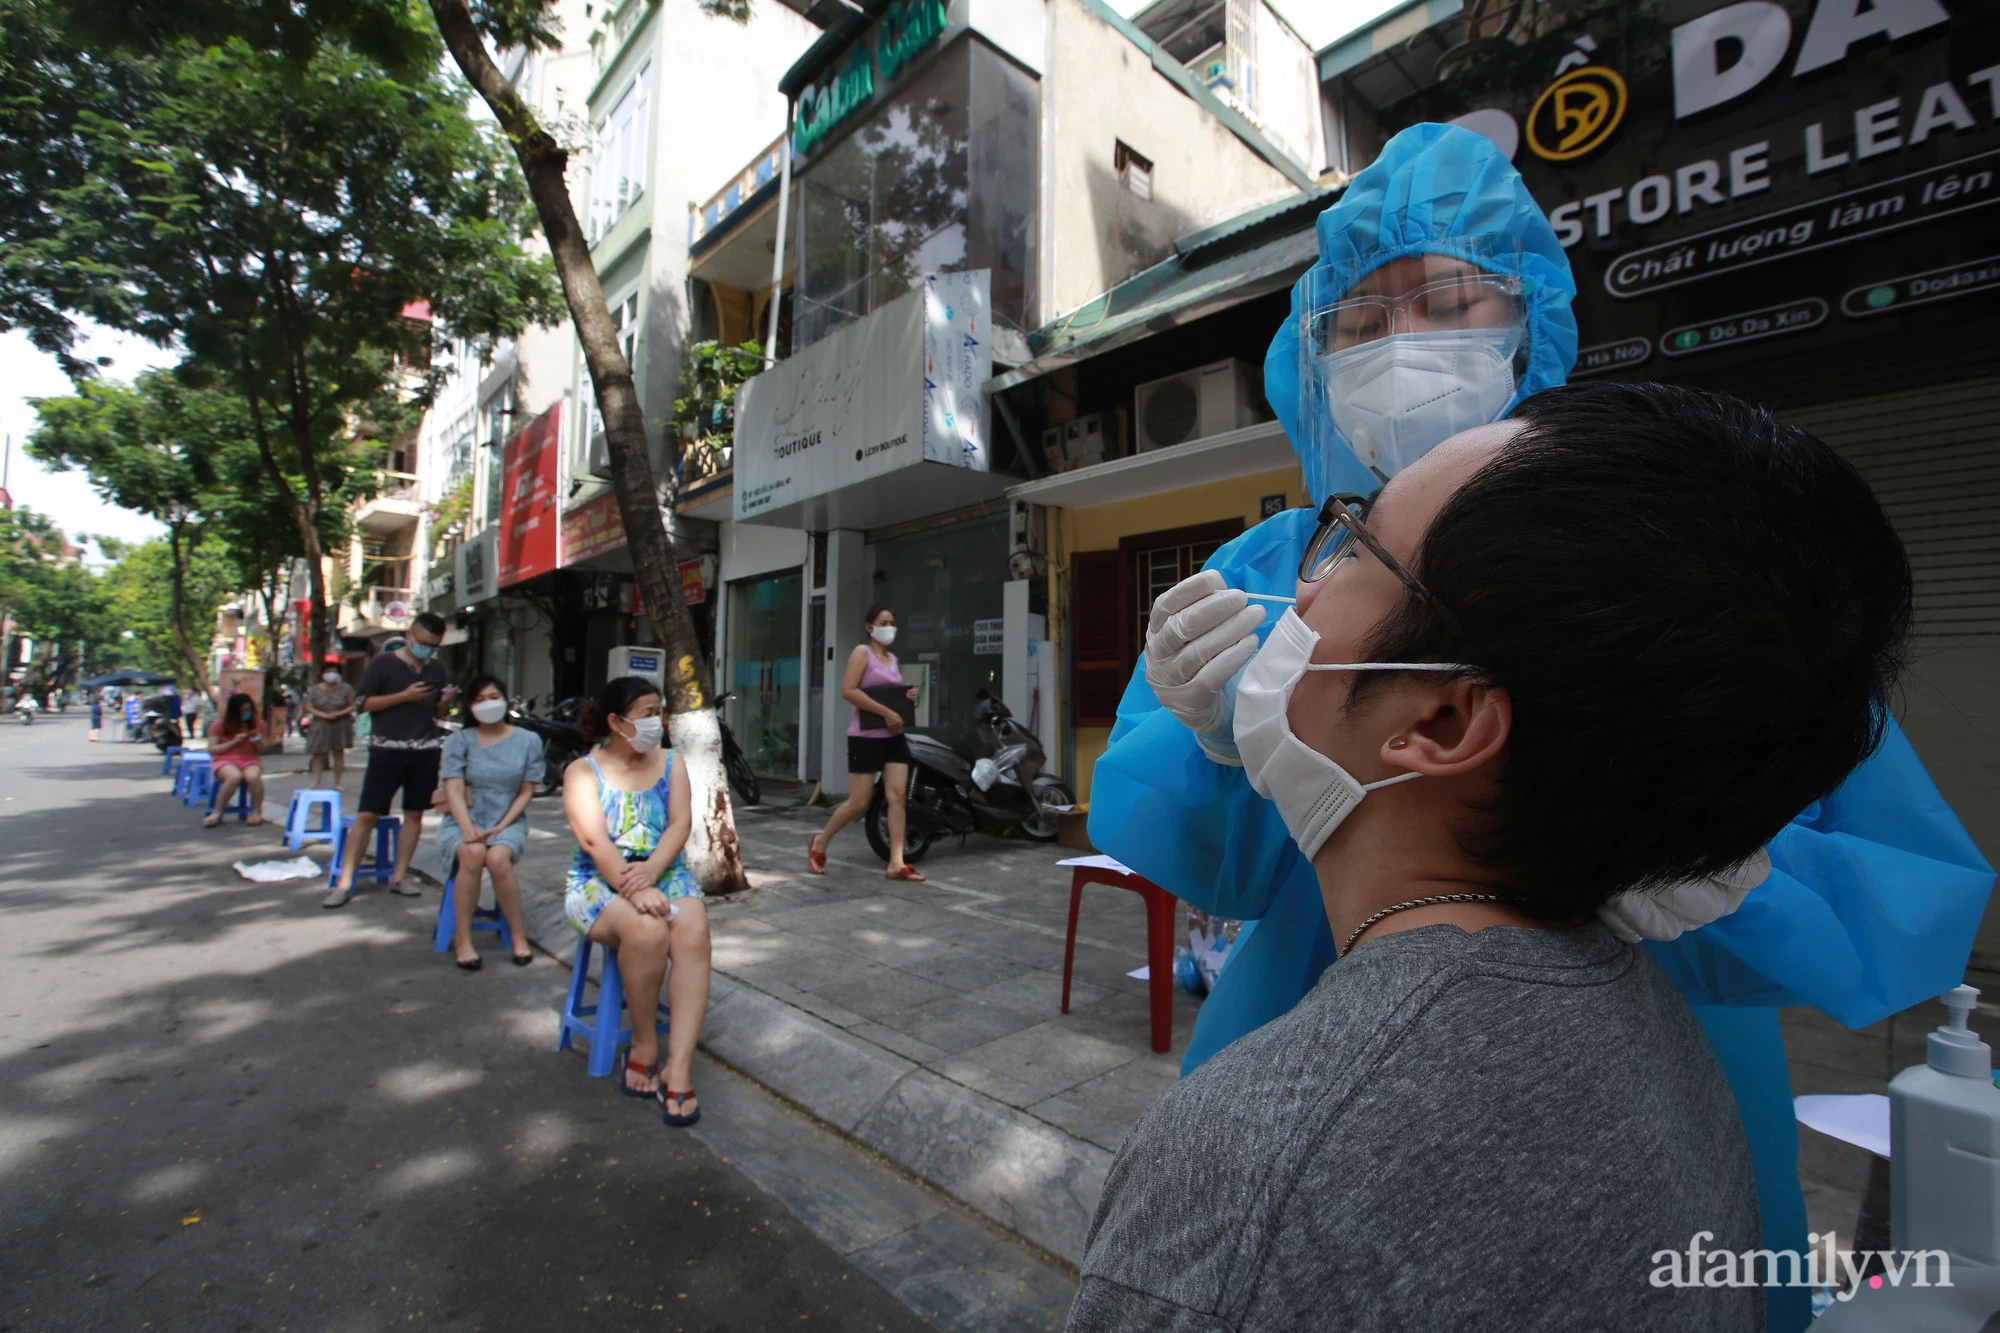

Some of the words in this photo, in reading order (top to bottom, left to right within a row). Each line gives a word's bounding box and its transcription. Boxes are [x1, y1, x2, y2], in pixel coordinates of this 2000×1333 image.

[1671, 0, 1952, 121] DA
[1550, 141, 1771, 249] STORE
[1616, 246, 1697, 286] Chất
[1705, 219, 1816, 263] lượng
[1828, 194, 1906, 231] làm
[1920, 170, 1994, 206] lên
[1264, 498, 1283, 515] 85
